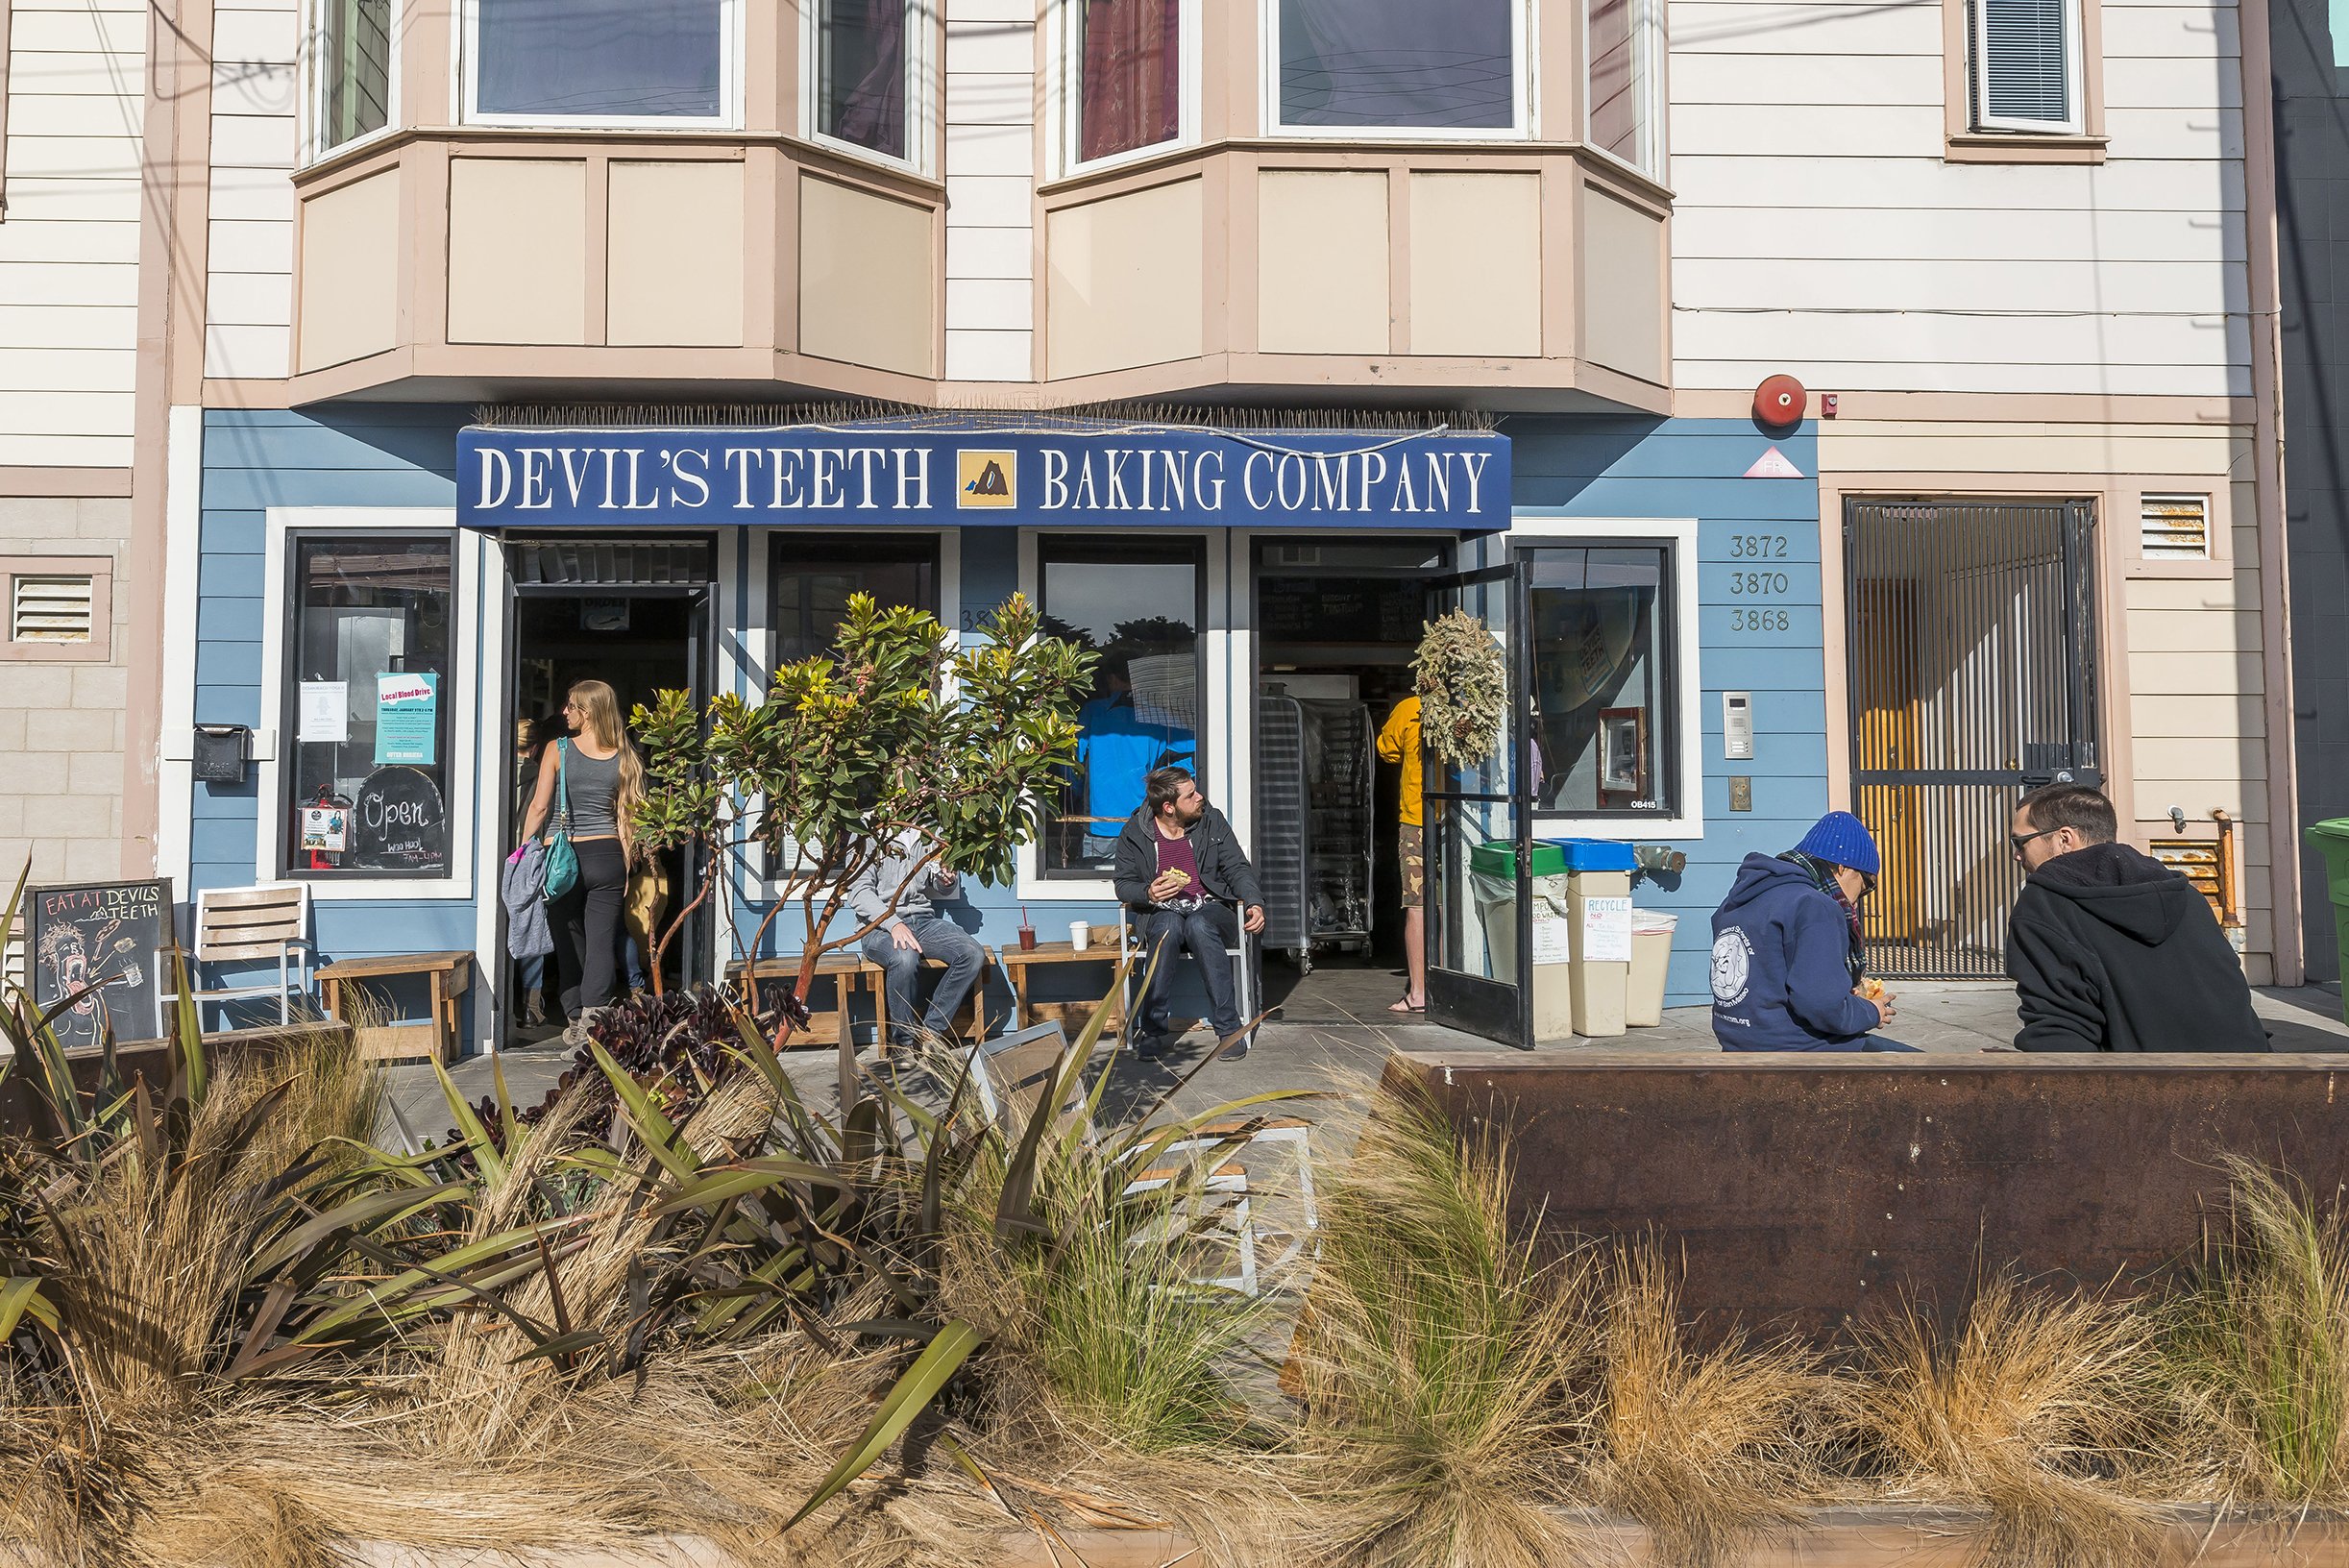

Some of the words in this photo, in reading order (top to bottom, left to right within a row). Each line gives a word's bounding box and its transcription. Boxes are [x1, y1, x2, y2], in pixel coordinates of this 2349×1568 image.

[473, 448, 710, 509] DEVIL'S
[724, 448, 933, 509] TEETH
[1039, 449, 1226, 511] BAKING
[1243, 450, 1493, 513] COMPANY
[1730, 535, 1787, 557] 3872
[1730, 573, 1788, 594] 3870
[1730, 609, 1789, 631] 3868
[381, 692, 398, 701] Local
[398, 690, 414, 698] Blood
[414, 688, 430, 697] Drive
[1630, 800, 1656, 809] OB415
[364, 789, 428, 842] Open
[45, 893, 76, 916] EAT
[81, 891, 101, 908] AT
[106, 886, 159, 906] DEVILS
[108, 904, 159, 919] TEETH
[1588, 899, 1627, 912] RECYCLE
[1731, 987, 1749, 1006] Mateo
